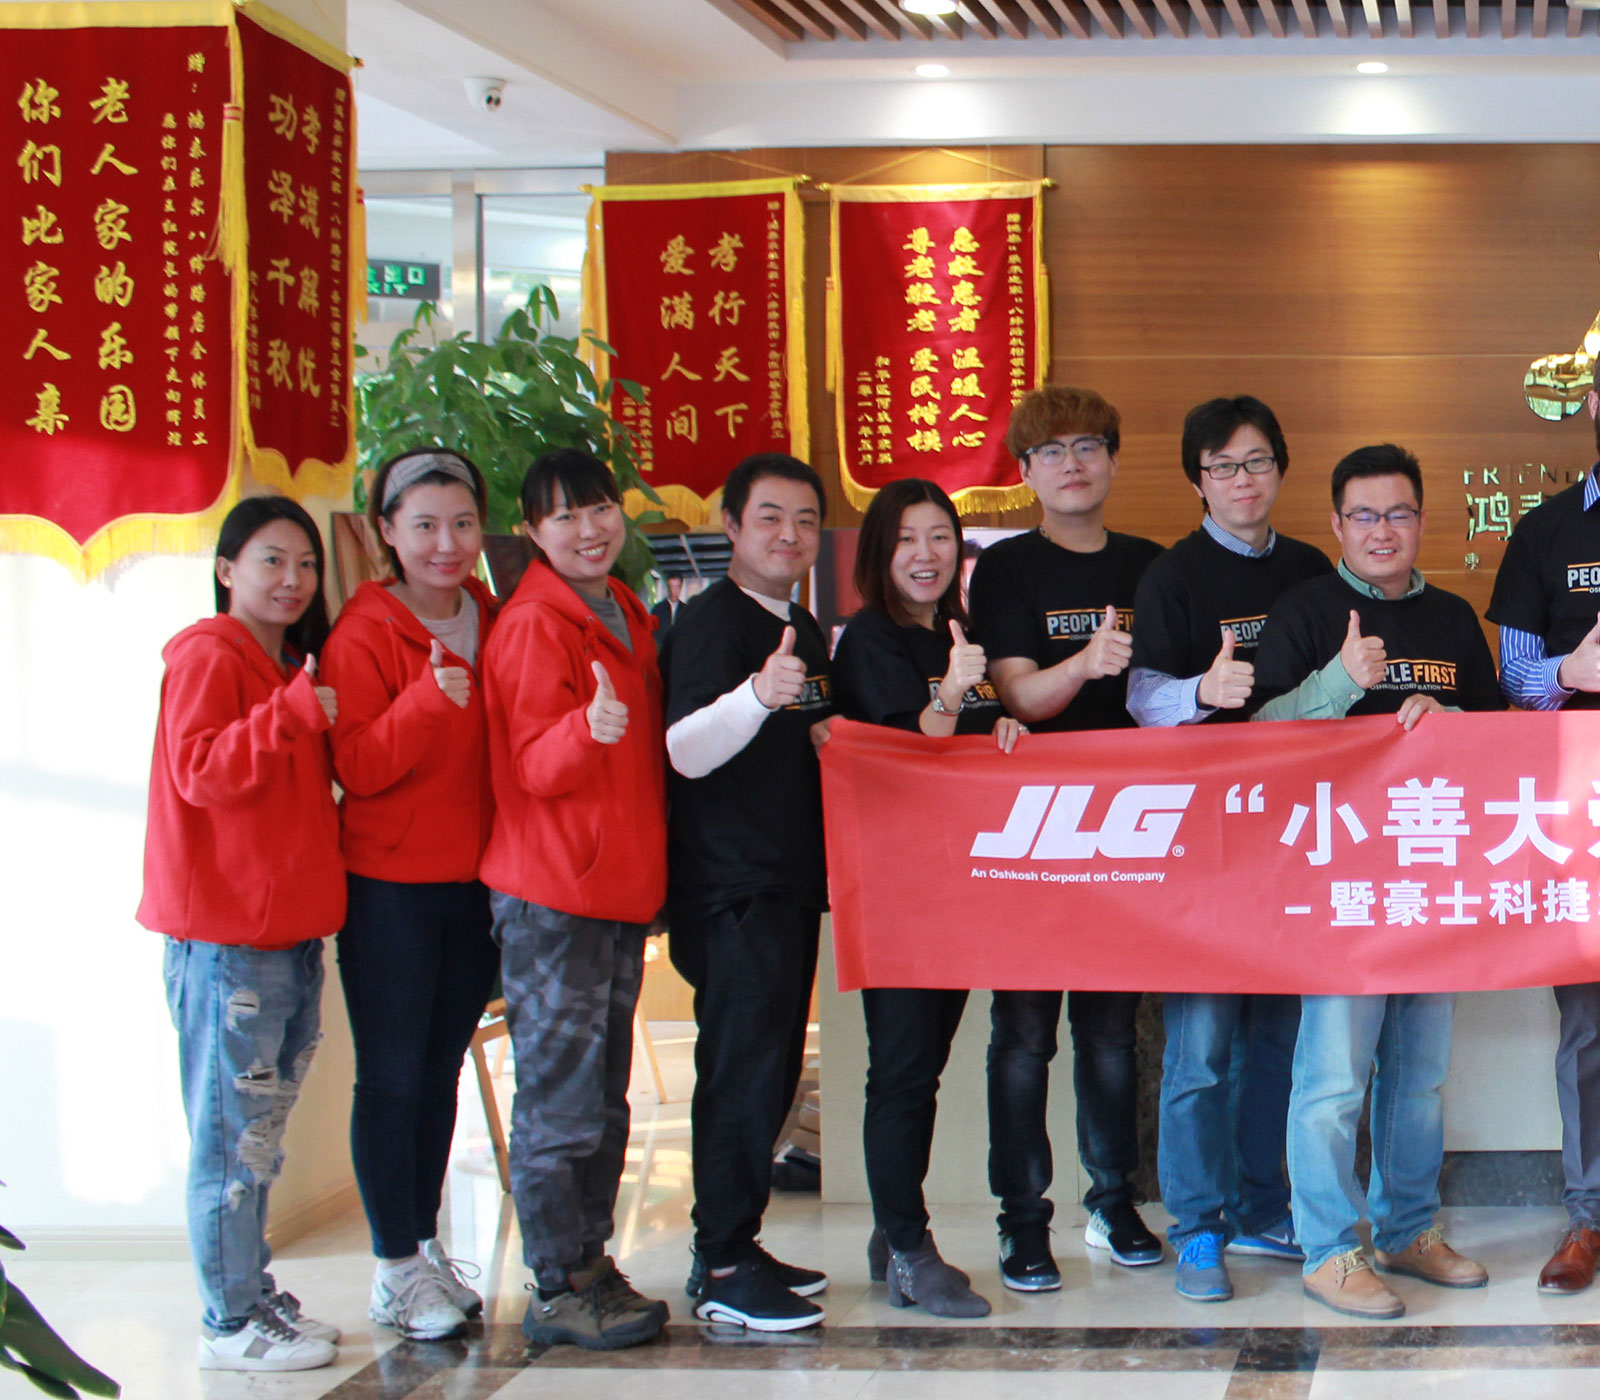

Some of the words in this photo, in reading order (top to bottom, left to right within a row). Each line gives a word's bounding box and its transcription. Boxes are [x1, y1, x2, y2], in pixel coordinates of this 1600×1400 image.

[17, 78, 71, 436] 你们比家人亲
[90, 77, 138, 433] 老人家的乐园
[267, 93, 297, 391] 功泽千秋
[902, 226, 942, 332] 尊老敬老
[660, 234, 703, 443] 爱满人间
[708, 231, 750, 439] 孝行天下
[905, 347, 944, 453] 爱民楷模
[949, 346, 989, 448] 温暖人心
[1413, 664, 1456, 686] FIRST
[969, 783, 1197, 860] JLG
[970, 868, 987, 878] An
[989, 868, 1039, 882] Oshkosh
[1110, 871, 1166, 883] Company
